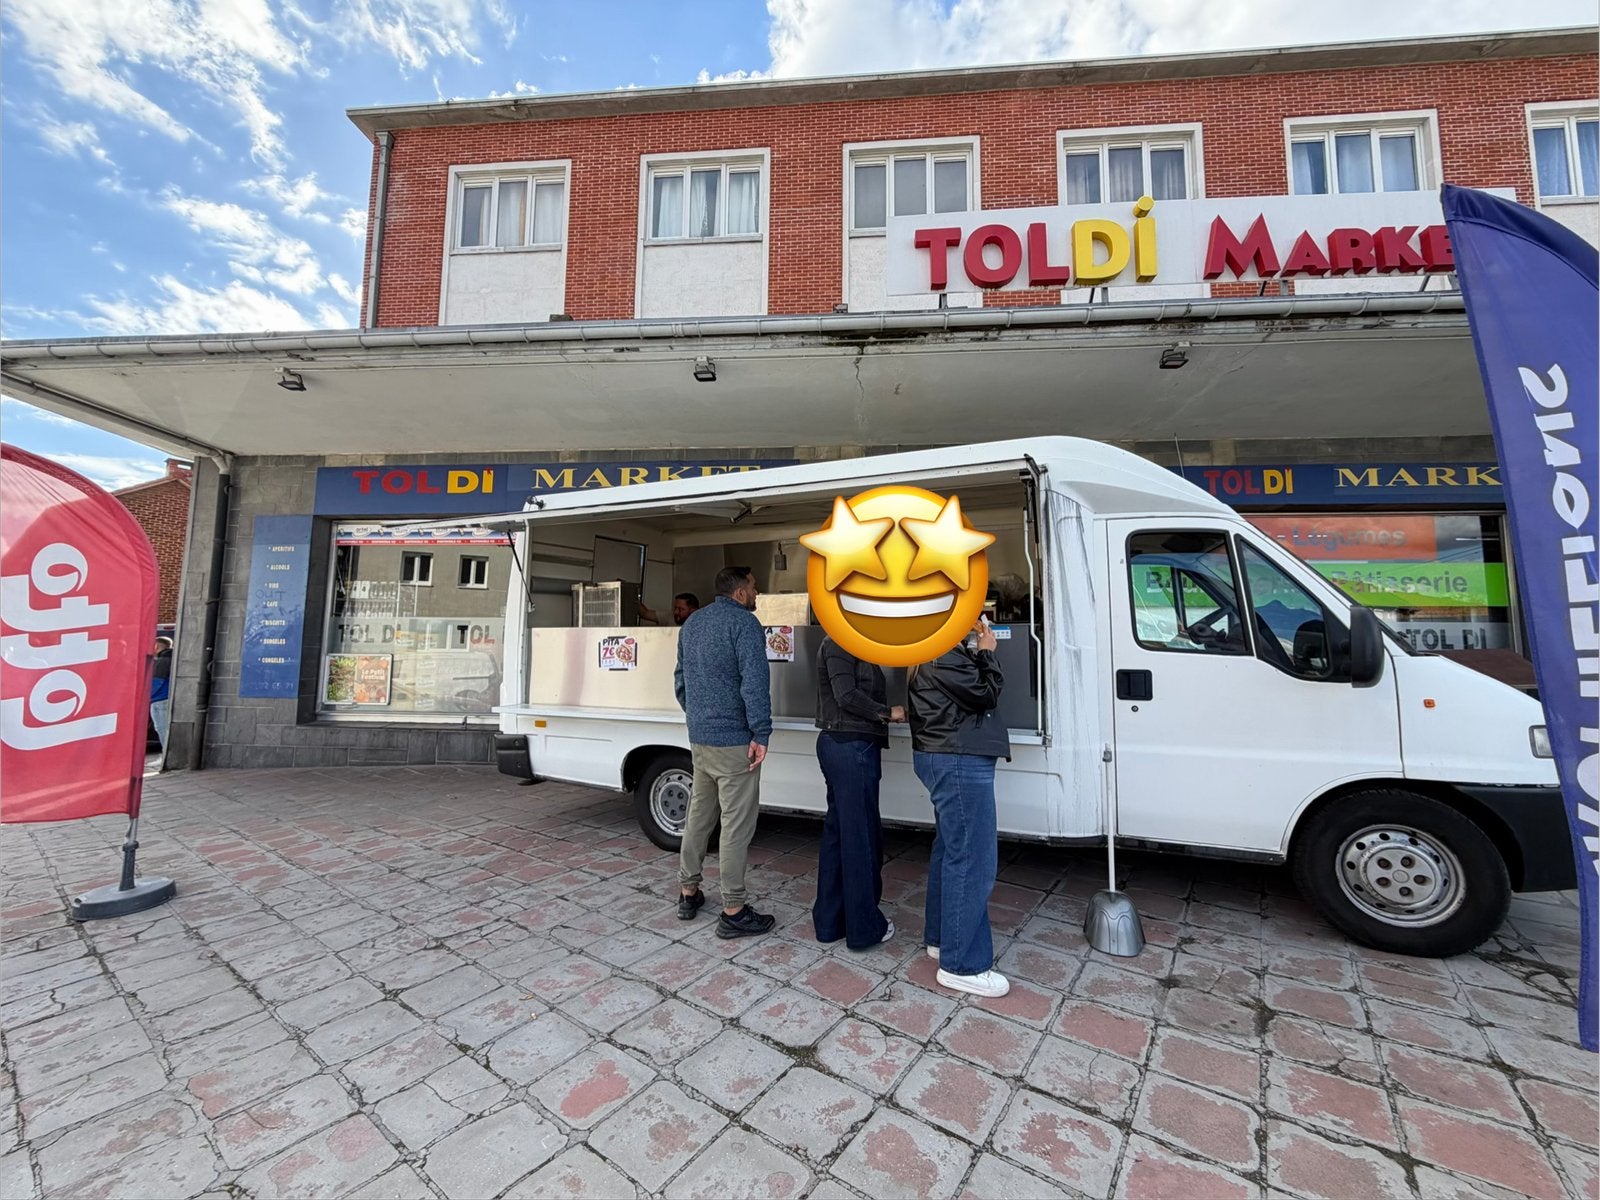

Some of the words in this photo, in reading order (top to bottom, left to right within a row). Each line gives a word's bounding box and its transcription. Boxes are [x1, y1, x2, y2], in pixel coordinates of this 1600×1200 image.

[1203, 212, 1457, 281] MARKE
[531, 465, 762, 489] MARK
[1333, 466, 1504, 488] MARK
